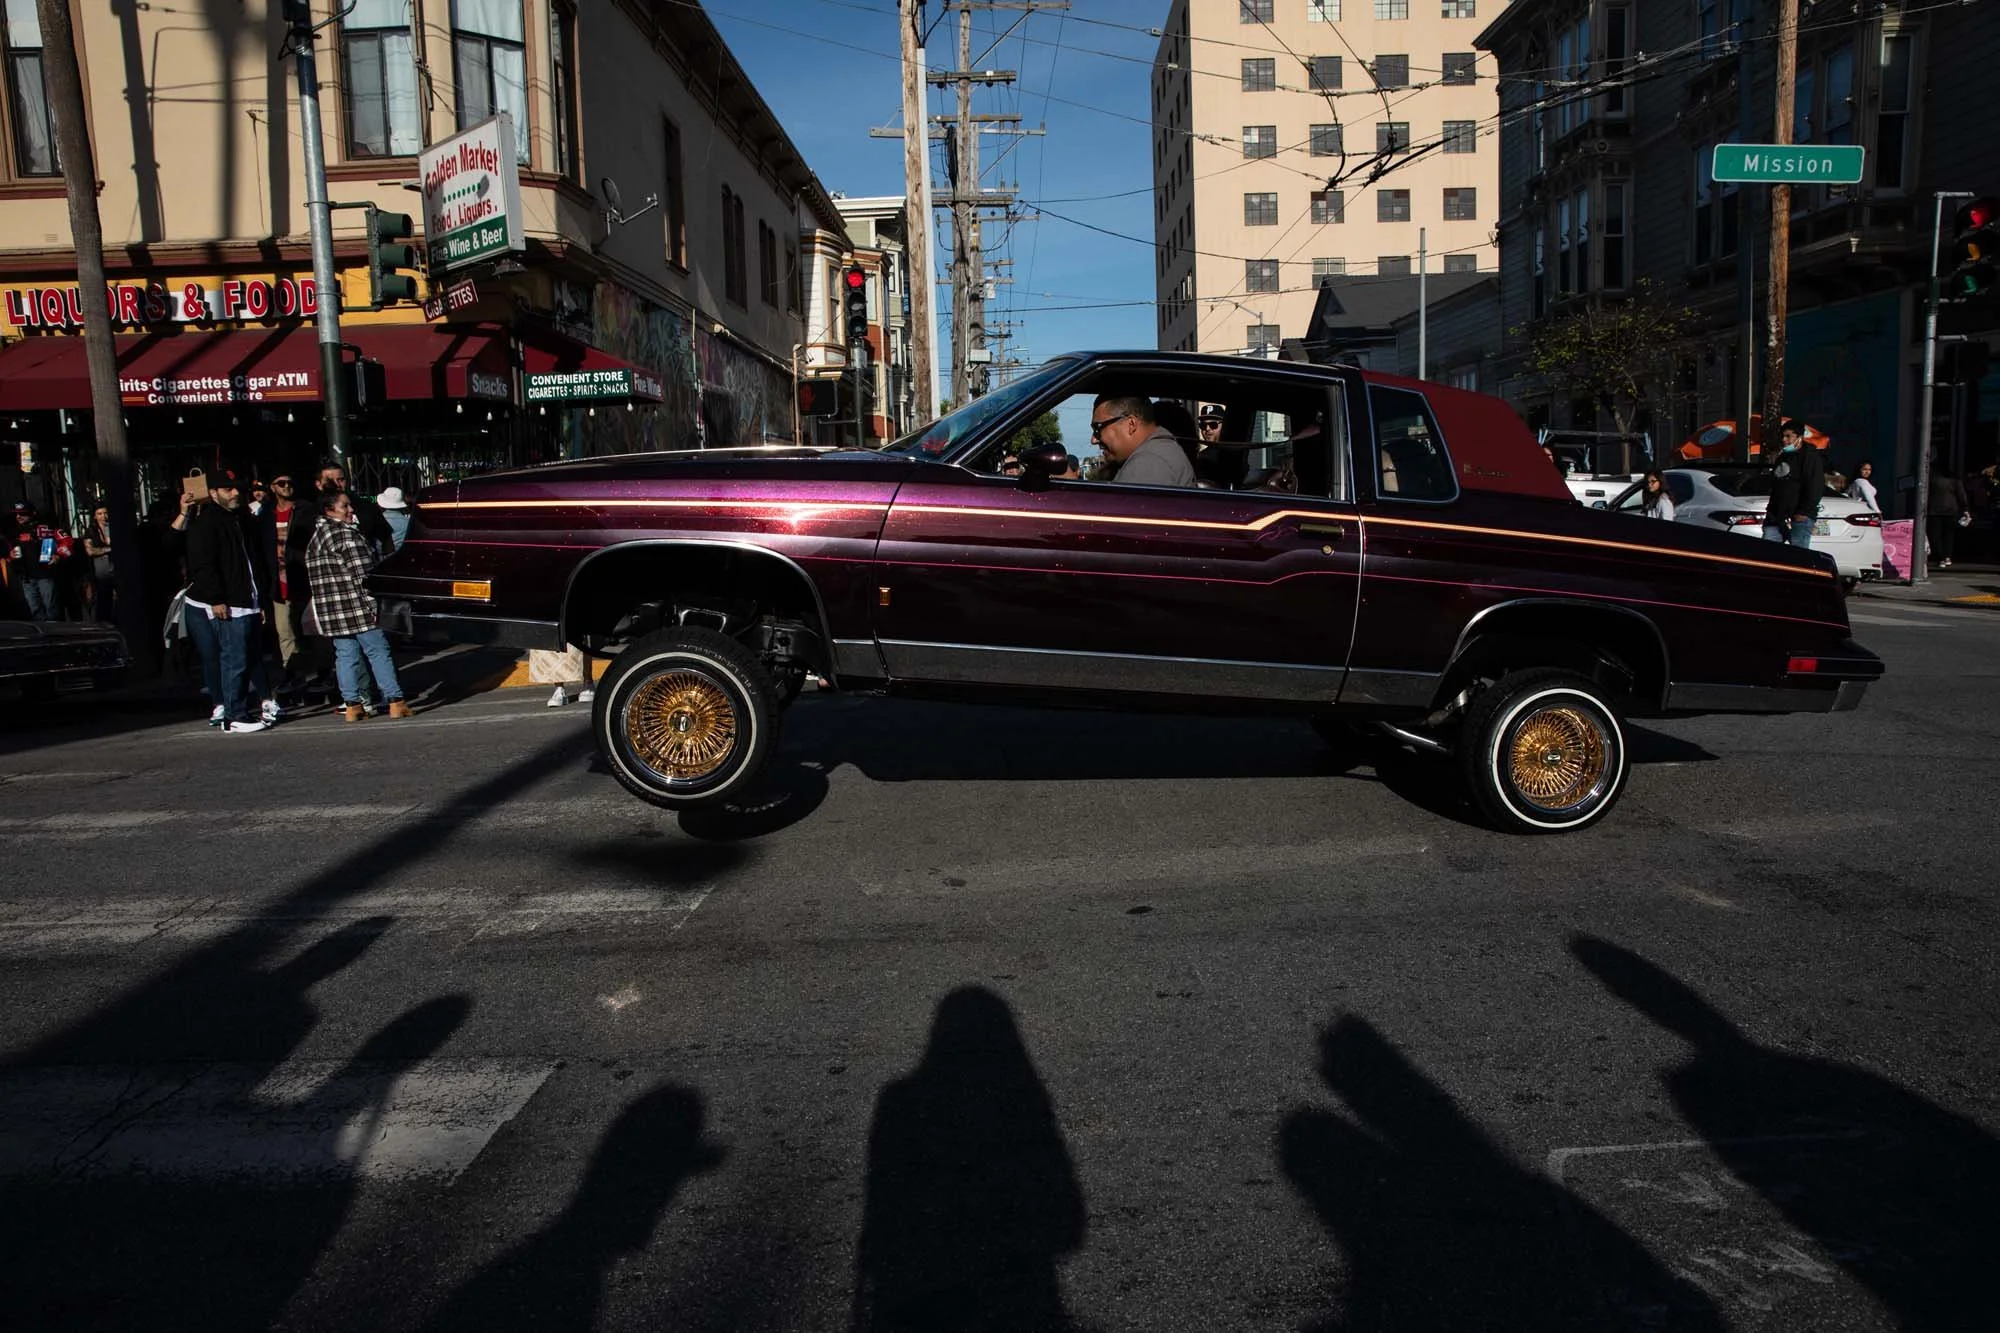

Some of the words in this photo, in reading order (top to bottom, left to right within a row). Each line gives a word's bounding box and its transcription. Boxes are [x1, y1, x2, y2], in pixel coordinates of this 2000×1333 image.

[425, 153, 458, 200] Golden
[459, 140, 499, 176] Market
[1743, 153, 1833, 173] Mission
[431, 208, 452, 234] Food
[458, 199, 492, 226] Liquors
[448, 238, 471, 258] Wine
[472, 231, 480, 250] &
[481, 227, 503, 247] Beer
[183, 282, 206, 320] &
[222, 278, 319, 318] FOOD
[120, 377, 148, 393] irits
[151, 376, 230, 393] Cigarettes
[234, 375, 273, 392] Cigar
[276, 373, 309, 387] ATM
[472, 373, 508, 398] Snacks
[531, 373, 591, 386] CONVENIENT
[593, 371, 624, 382] STORE
[634, 374, 647, 391] Fine
[147, 391, 223, 405] Convenient
[227, 389, 263, 402] Store
[528, 385, 568, 399] CIGARETTES
[573, 385, 598, 396] SPIRITS
[603, 382, 629, 394] SNACKS
[1206, 405, 1214, 415] P
